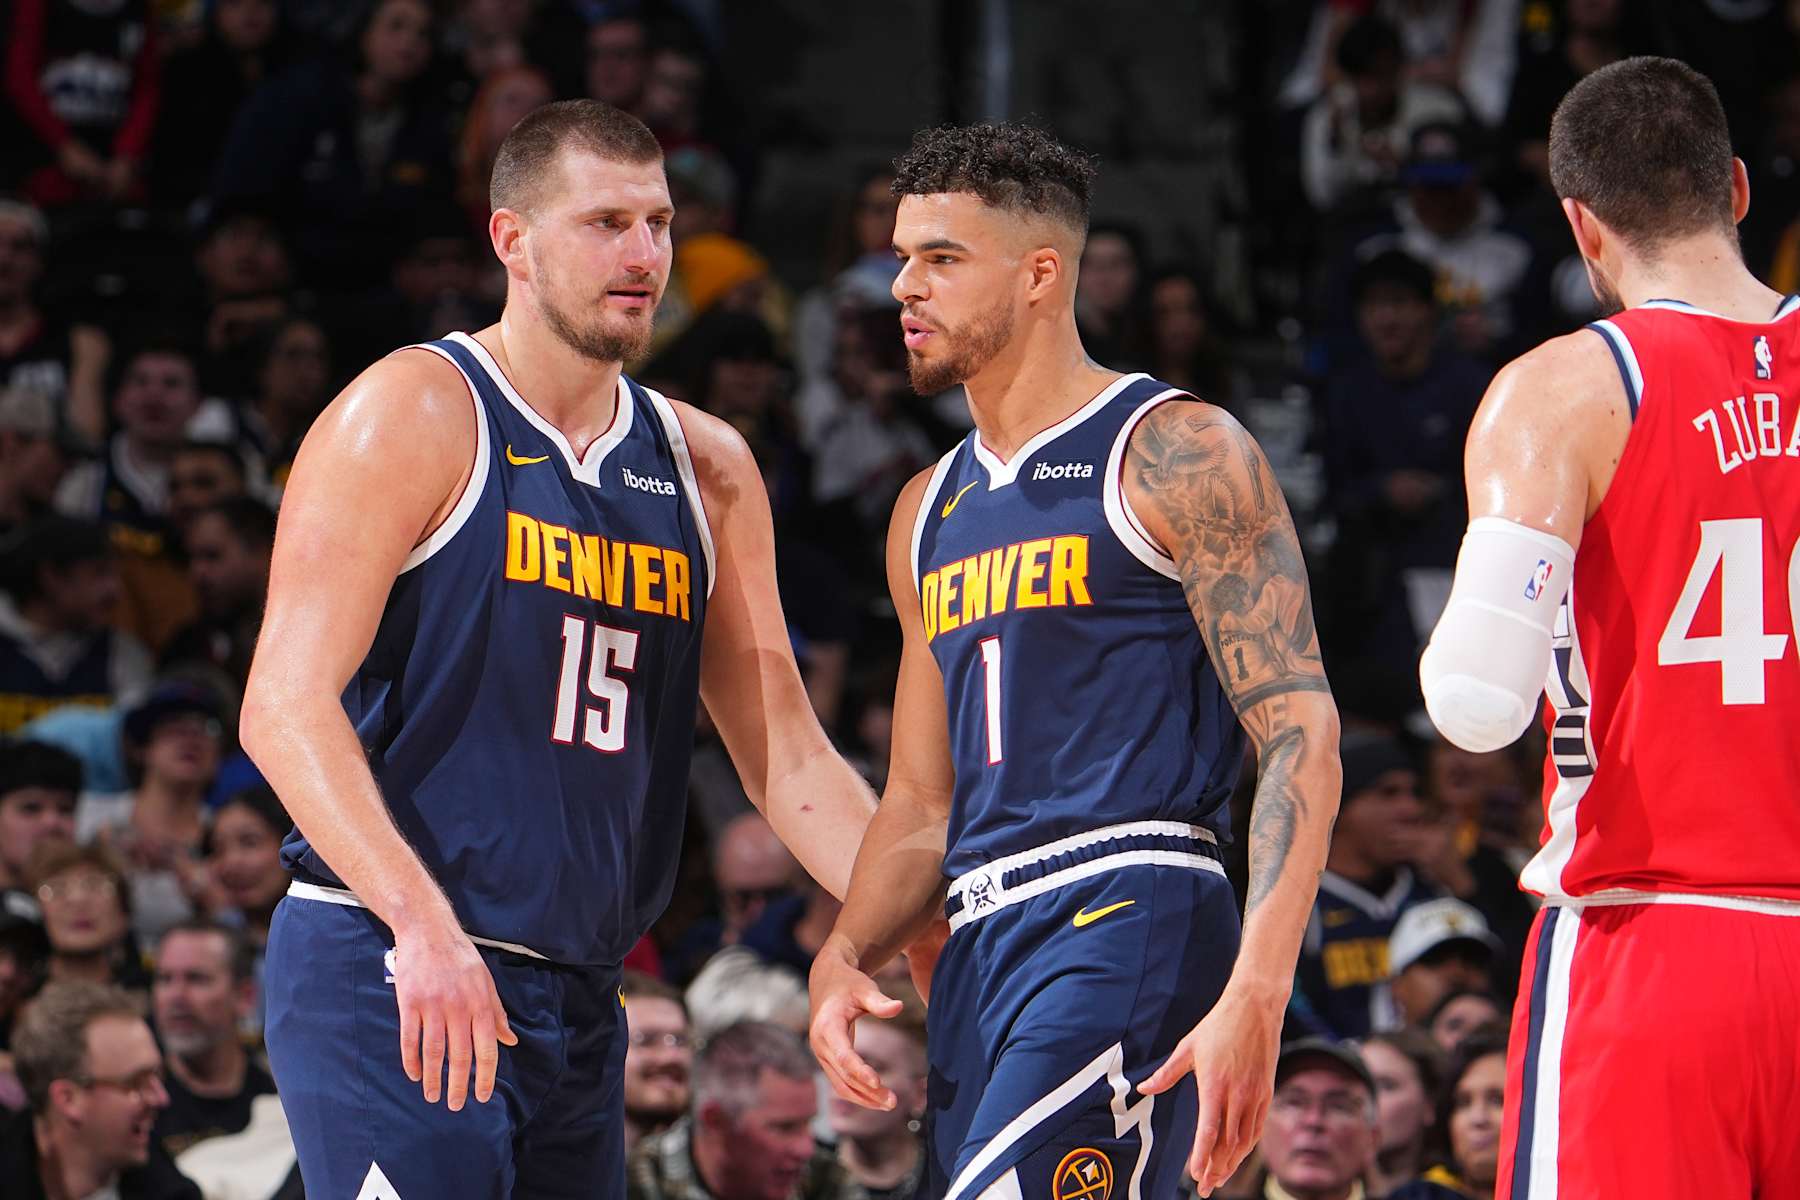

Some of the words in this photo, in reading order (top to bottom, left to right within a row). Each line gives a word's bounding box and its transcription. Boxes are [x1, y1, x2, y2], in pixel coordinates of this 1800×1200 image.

[622, 467, 677, 496] ibotta
[1032, 462, 1094, 481] ibotta
[504, 509, 691, 623] DENVER
[922, 533, 1095, 645] DENVER
[1658, 517, 1800, 705] 4
[550, 612, 641, 754] 15
[978, 634, 1004, 768] 1
[1233, 647, 1250, 681] 1
